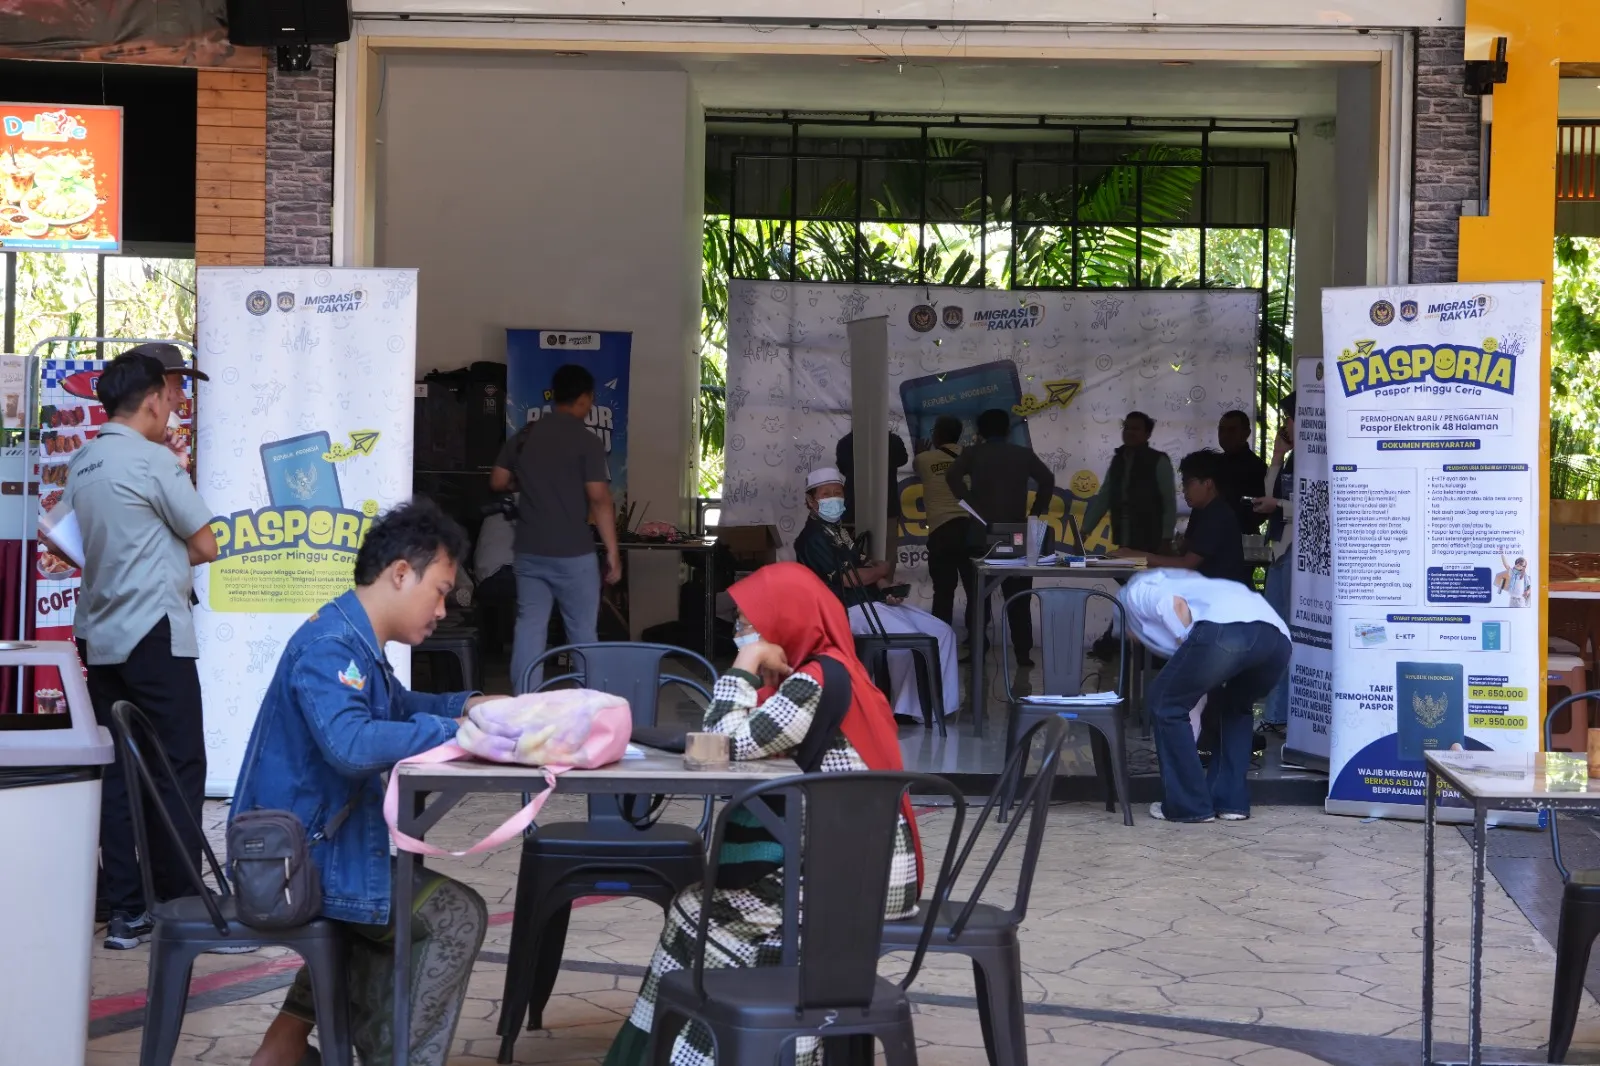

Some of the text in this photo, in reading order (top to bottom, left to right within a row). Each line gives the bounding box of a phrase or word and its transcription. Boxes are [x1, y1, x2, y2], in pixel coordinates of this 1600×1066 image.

[304, 293, 353, 305] IMIGRASI
[316, 302, 361, 314] RAKYAT
[1427, 300, 1476, 313] IMIGRASI
[973, 307, 1028, 321] IMIGRASI
[1440, 308, 1485, 322] RAKYAT
[987, 318, 1037, 331] RAKYAT
[1341, 347, 1511, 393] PASPORIA
[922, 384, 999, 408] REPUBLIK INDONESIA
[1375, 384, 1482, 398] Paspor Minggu Ceria
[1360, 415, 1416, 423] PERMOHONAN
[1417, 414, 1438, 422] BARU
[1444, 413, 1499, 422] PENGGANTIAN
[1360, 422, 1499, 433] Paspor Elektronik 48 Halaman
[1382, 441, 1476, 449] DOKUMEN PERSYARATAN
[209, 510, 374, 555] PASPORI
[242, 551, 357, 564] Paspor Minggu Ceri
[274, 568, 295, 577] Minggu
[1296, 664, 1323, 679] PENDAPAT
[1291, 674, 1332, 693] MEMBANTU KA
[1369, 685, 1394, 693] TARIF
[1294, 685, 1319, 701] IMIGRASI
[1334, 692, 1394, 702] PERMOHONAN
[1472, 689, 1524, 698] RP. 650.000
[1291, 696, 1332, 715] UNTUK MEMBE
[1359, 702, 1394, 711] PASPOR
[1290, 706, 1324, 723] PELAYANAN
[1473, 718, 1524, 727] RP. 950.000
[1312, 723, 1327, 735] BAIK
[1357, 768, 1428, 779] WAJIB MEMBAWA
[1364, 777, 1394, 786] BERKAS
[1395, 779, 1412, 787] ASLI
[1372, 786, 1460, 798] BERPAKAIAN DAN
